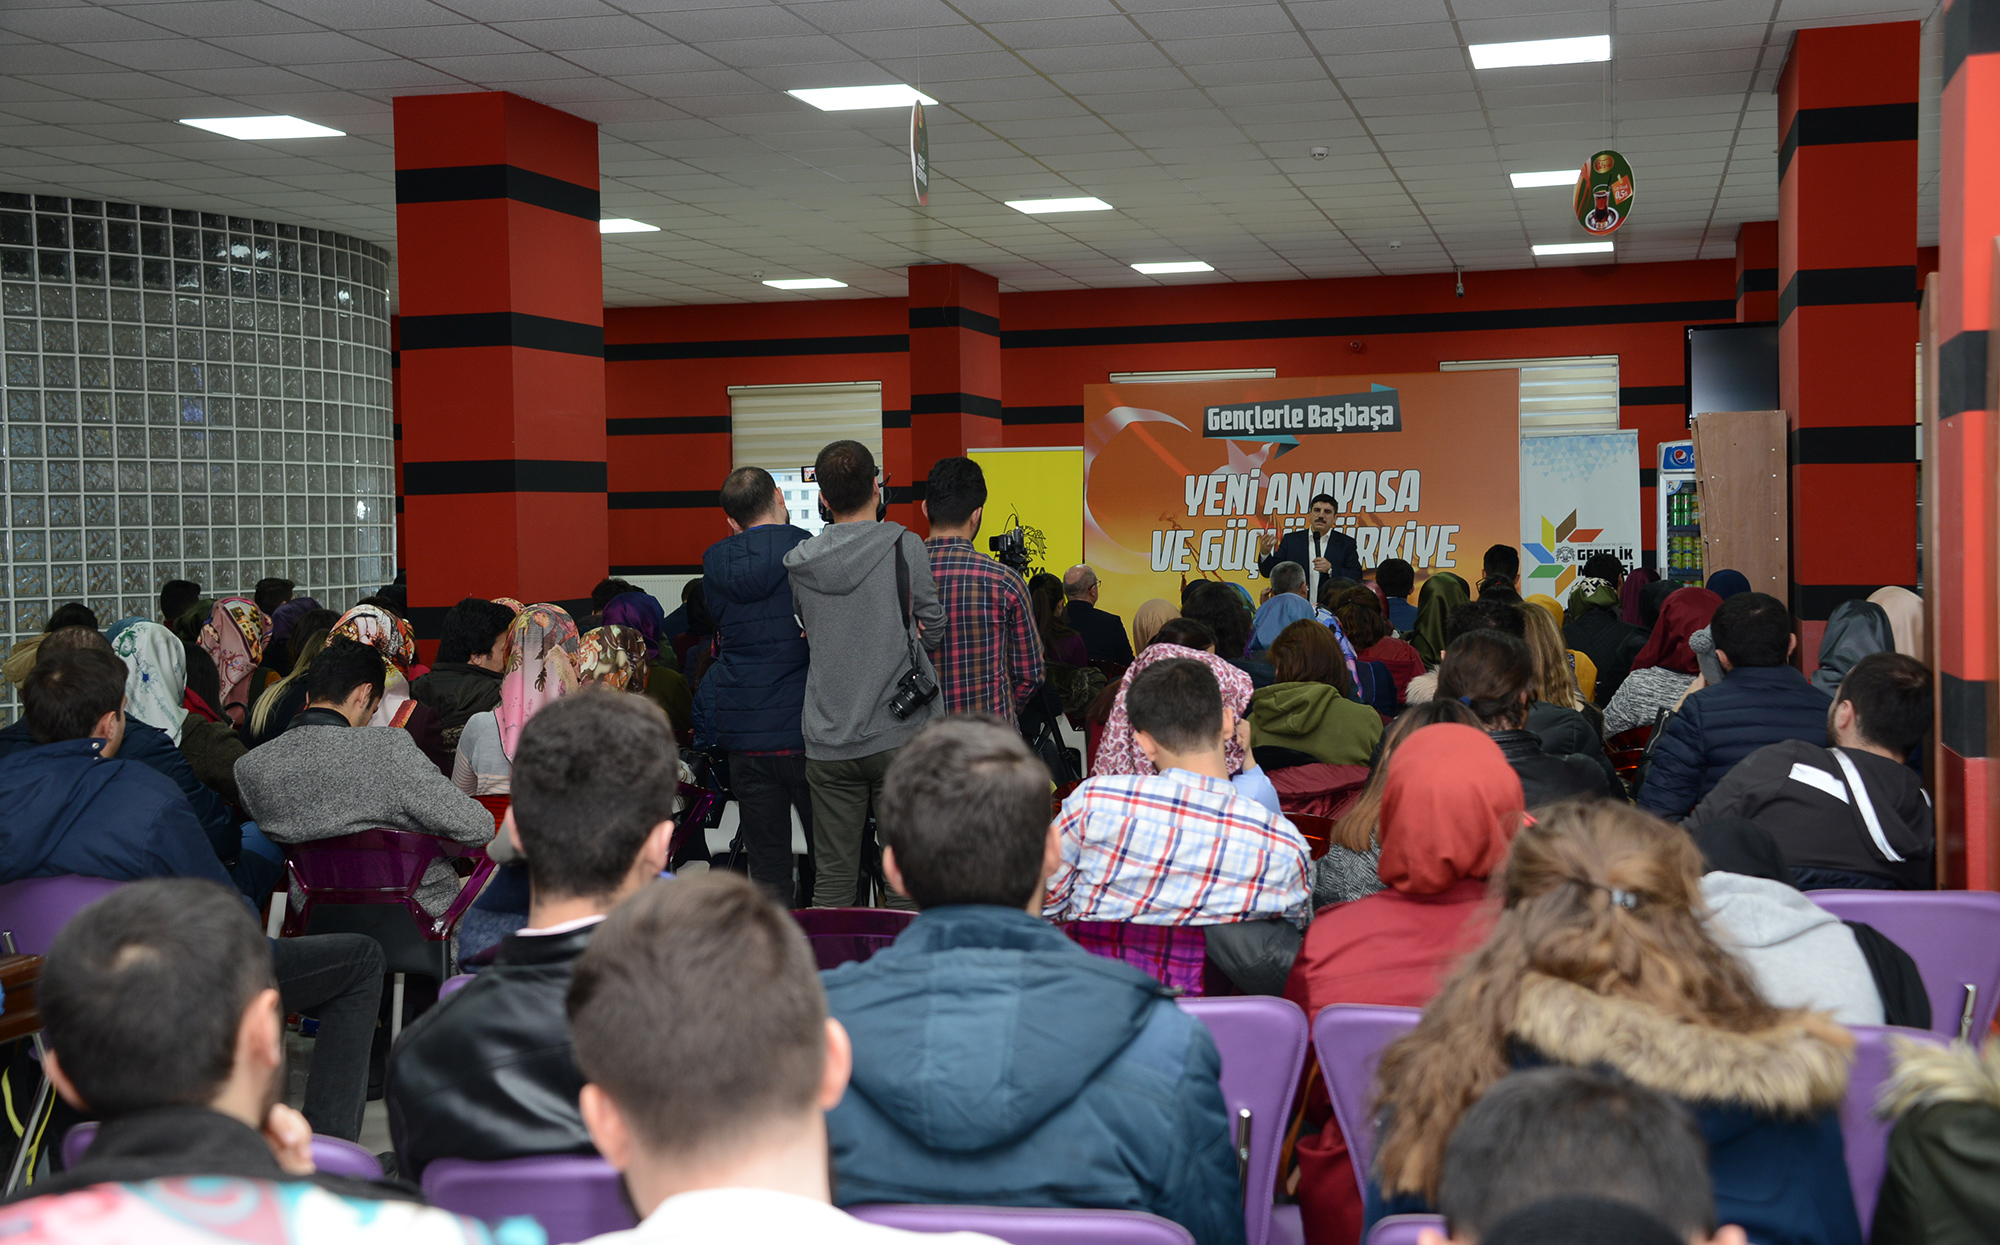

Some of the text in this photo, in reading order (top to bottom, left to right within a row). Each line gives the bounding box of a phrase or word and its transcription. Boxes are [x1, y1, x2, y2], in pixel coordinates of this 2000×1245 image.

[1207, 402, 1394, 435] Gençlerle Başbaşa
[1184, 468, 1262, 517] YENİ
[1150, 516, 1460, 579] VE GÜÇ RKİYE
